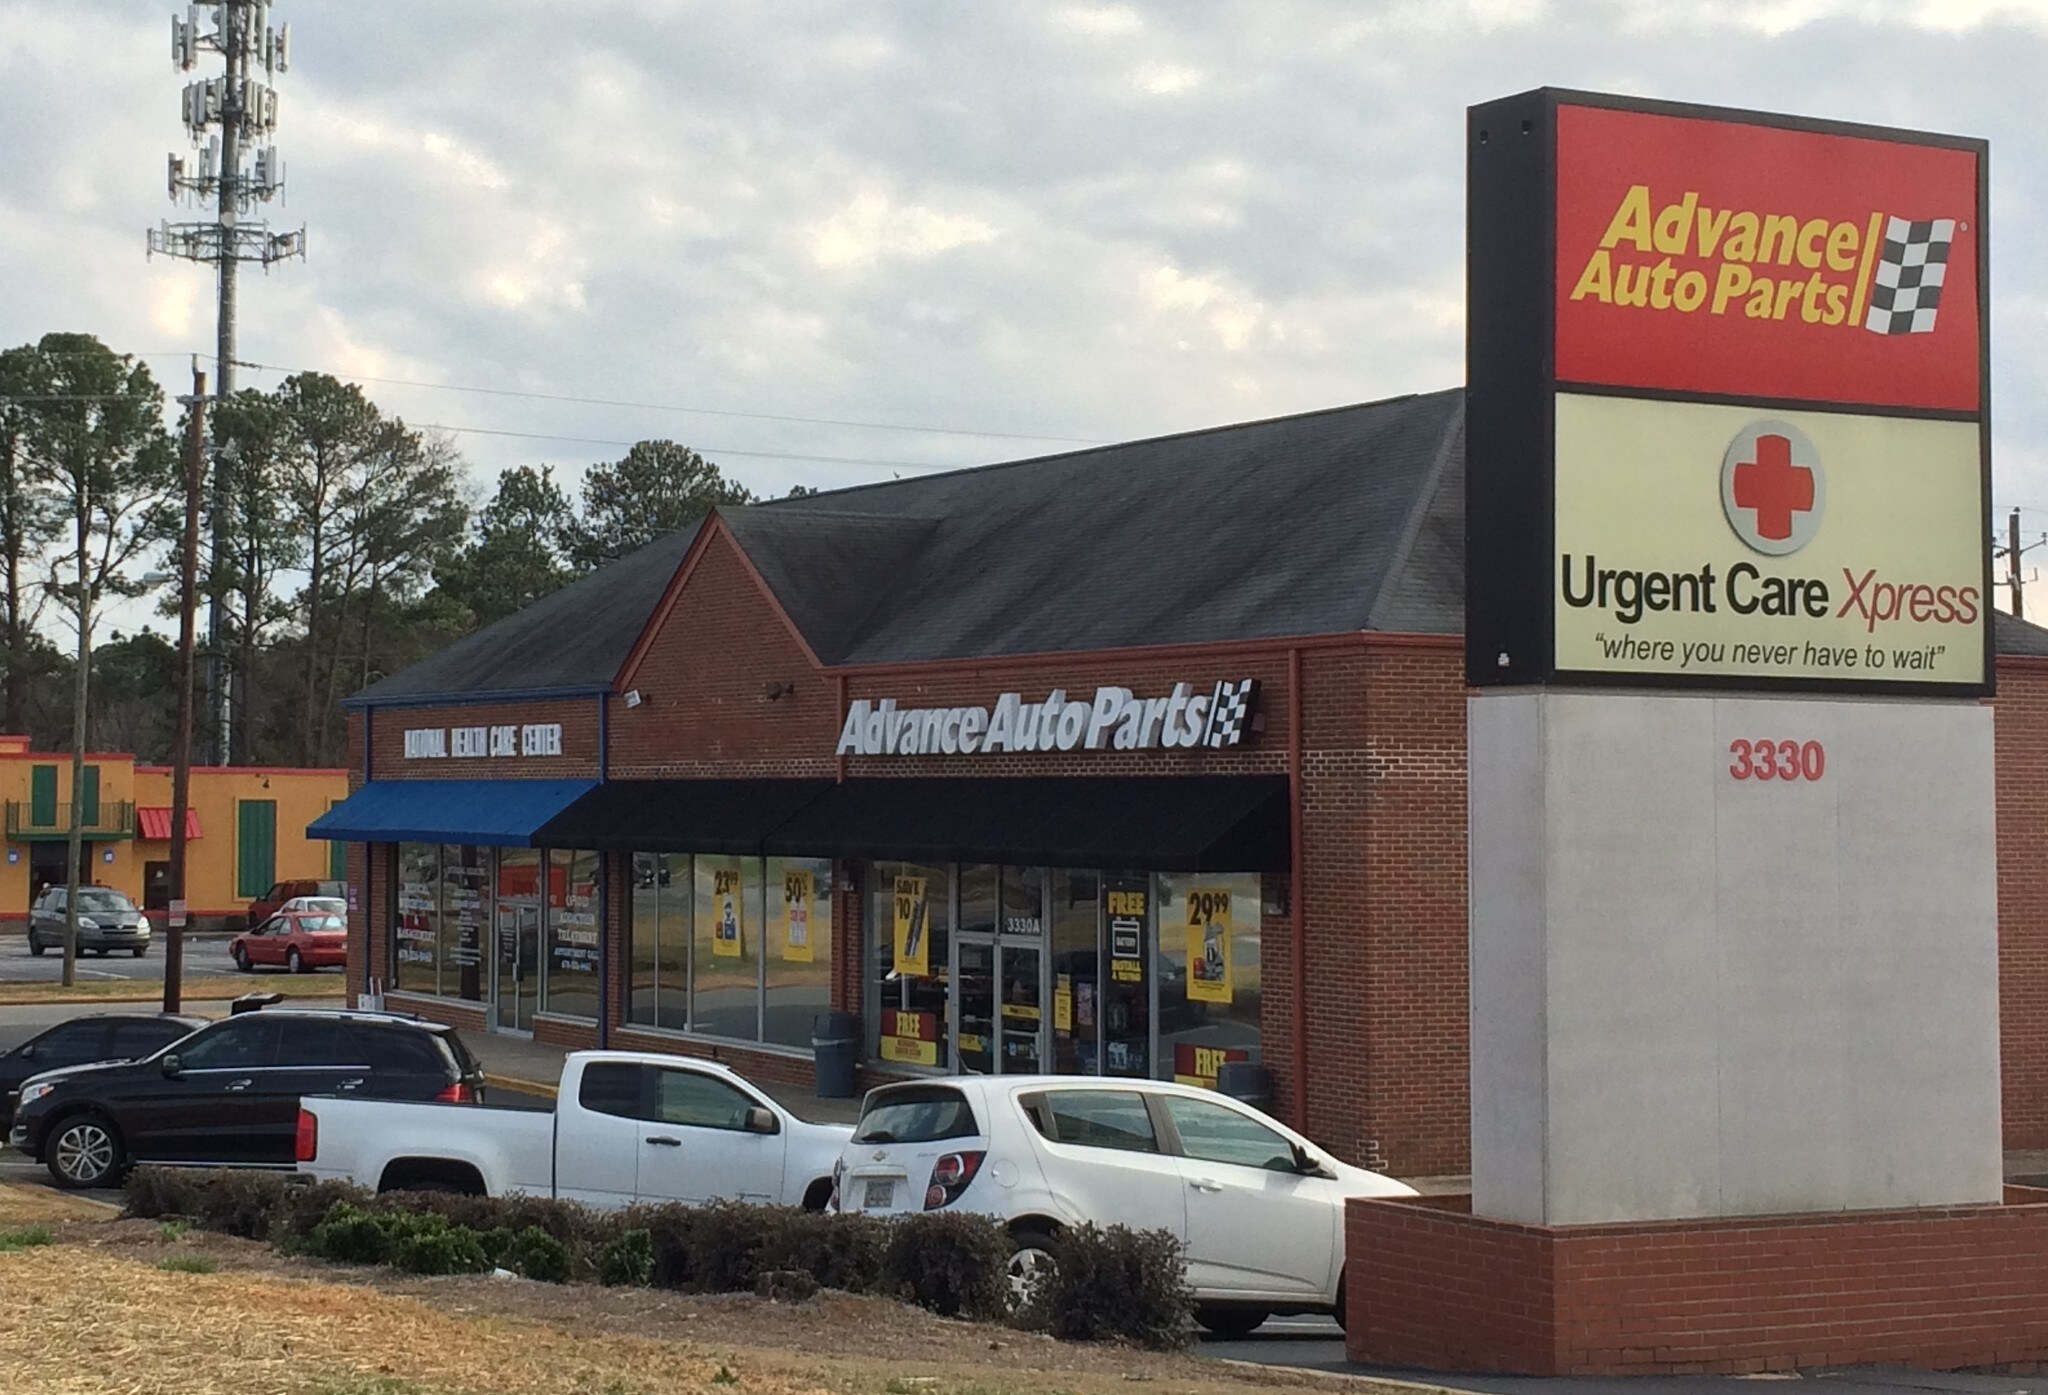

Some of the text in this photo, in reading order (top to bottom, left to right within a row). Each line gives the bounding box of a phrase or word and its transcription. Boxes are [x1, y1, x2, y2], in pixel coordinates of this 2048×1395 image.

[1599, 184, 1860, 272] Advance
[1569, 250, 1850, 326] Auto Parts
[1561, 553, 1980, 634] Urgent Care Xpress
[1679, 641, 1724, 668] you
[1731, 643, 1798, 666] never
[1803, 641, 1858, 668] have
[1864, 645, 1885, 668] to
[836, 681, 1208, 756] Advance Auto Parts
[490, 725, 518, 757] CARE
[522, 723, 562, 757] CENTER
[1729, 738, 1825, 781] 3330
[1108, 890, 1145, 915] FREE
[1007, 917, 1041, 934] 3330A
[895, 1010, 921, 1039] FREE
